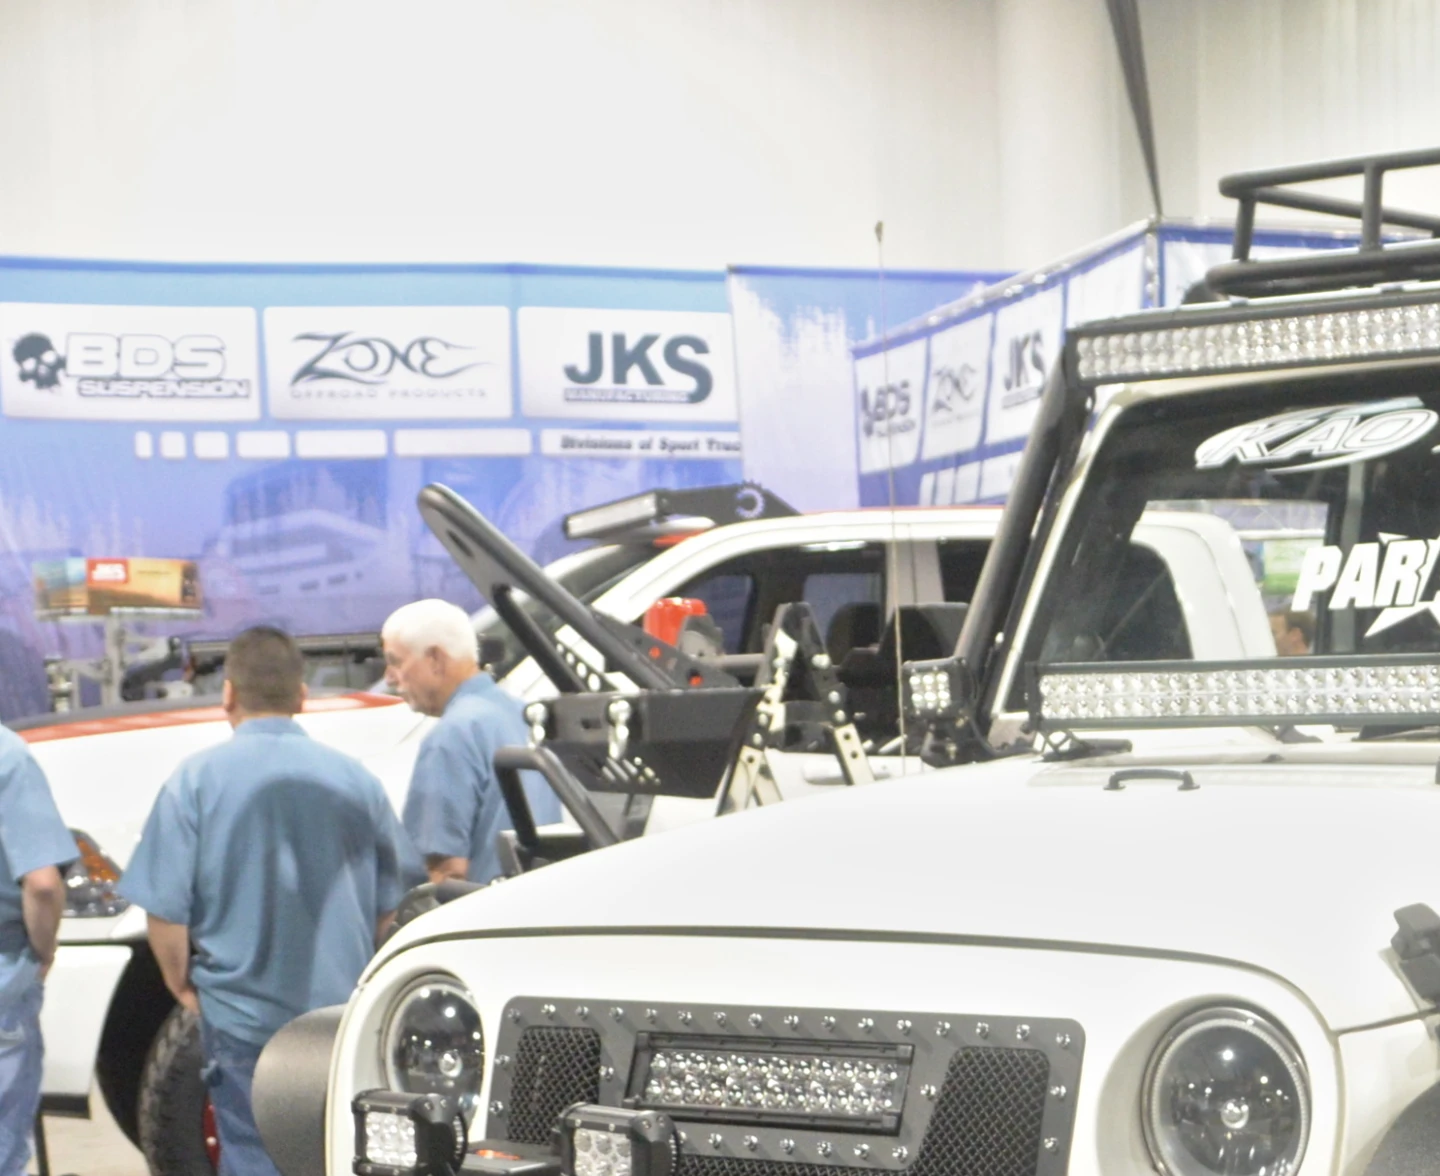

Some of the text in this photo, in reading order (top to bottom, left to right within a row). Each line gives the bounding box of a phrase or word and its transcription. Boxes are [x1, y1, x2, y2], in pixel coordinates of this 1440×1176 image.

[65, 332, 227, 380] BDS
[290, 331, 492, 387] ZONE
[563, 332, 714, 404] JKS
[1004, 330, 1046, 397] JKS
[77, 379, 250, 398] SUSPENSION
[638, 437, 653, 451] of
[1196, 405, 1438, 472] KAO
